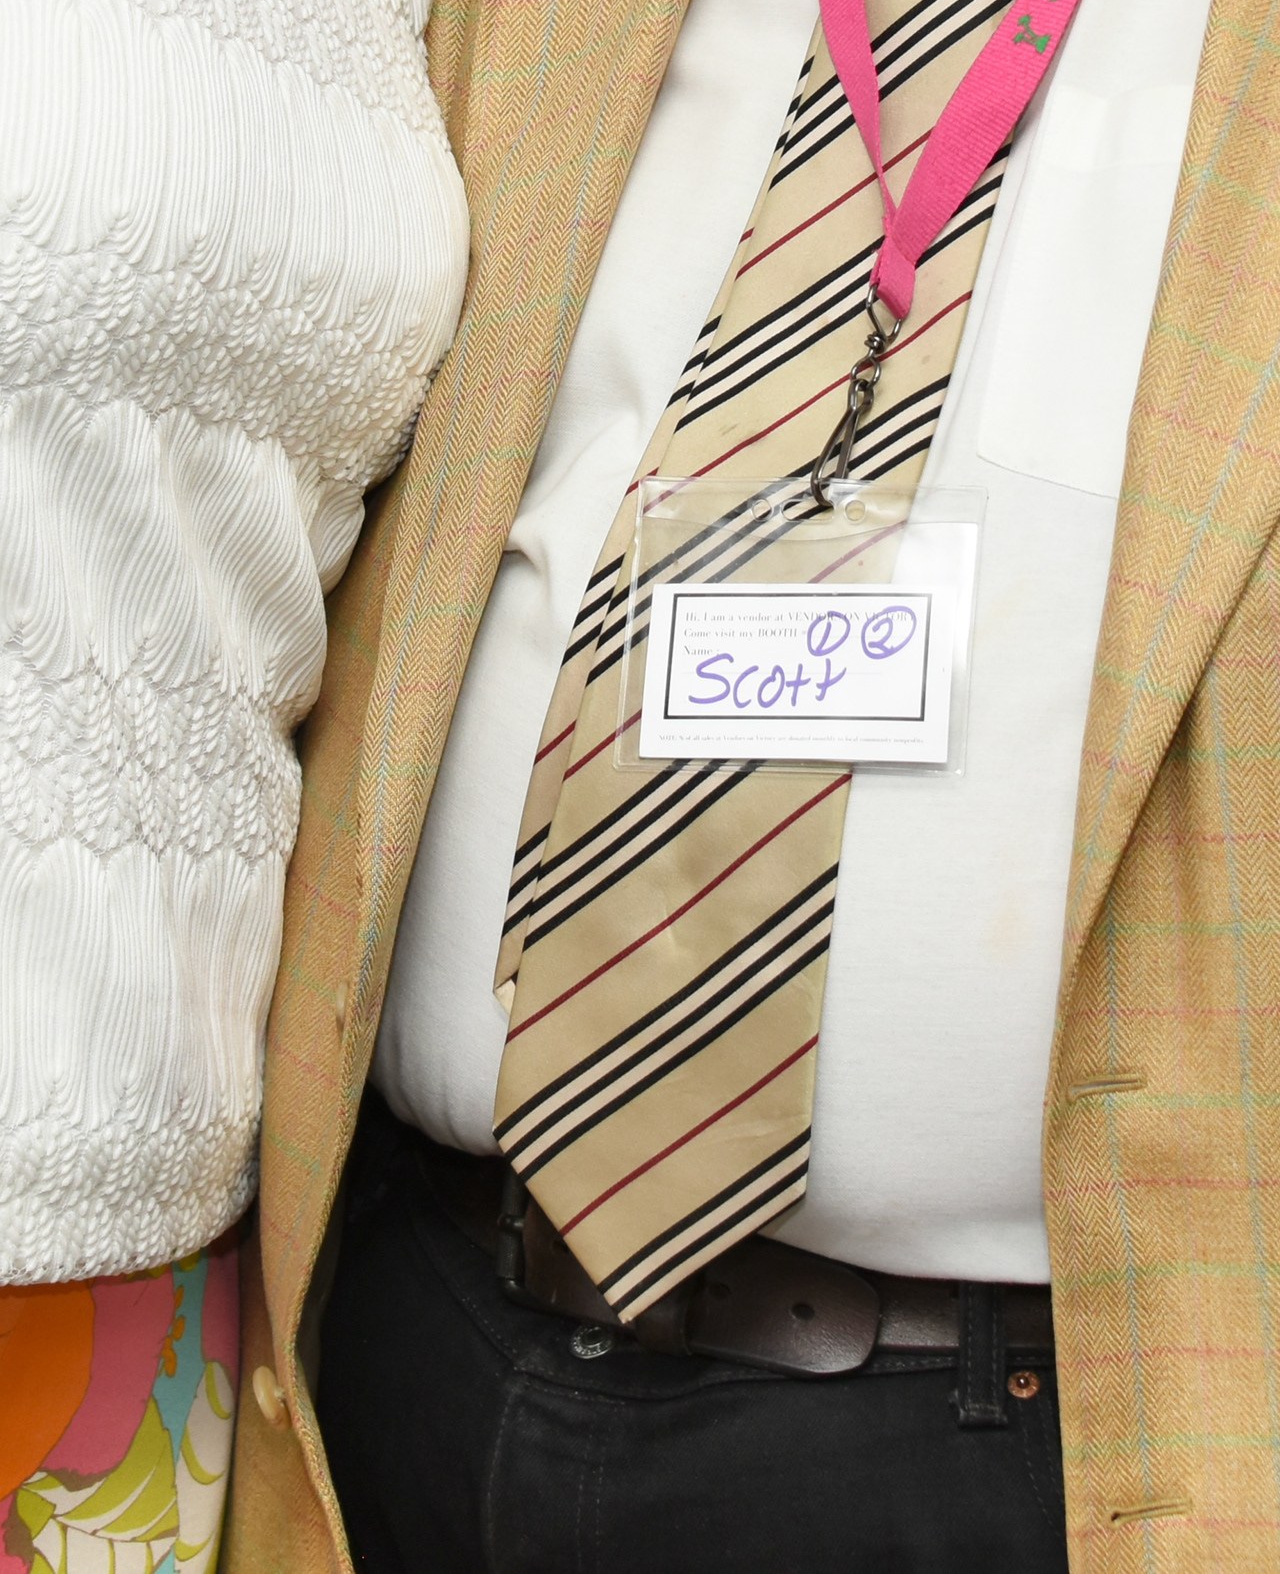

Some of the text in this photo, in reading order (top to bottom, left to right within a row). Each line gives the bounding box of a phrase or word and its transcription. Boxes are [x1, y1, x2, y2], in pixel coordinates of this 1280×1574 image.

[738, 612, 771, 621] vendor
[844, 612, 859, 622] ON
[684, 628, 711, 637] Come
[715, 629, 735, 638] visit
[739, 631, 753, 640] my
[758, 629, 797, 637] BOOTH
[684, 645, 712, 655] Name
